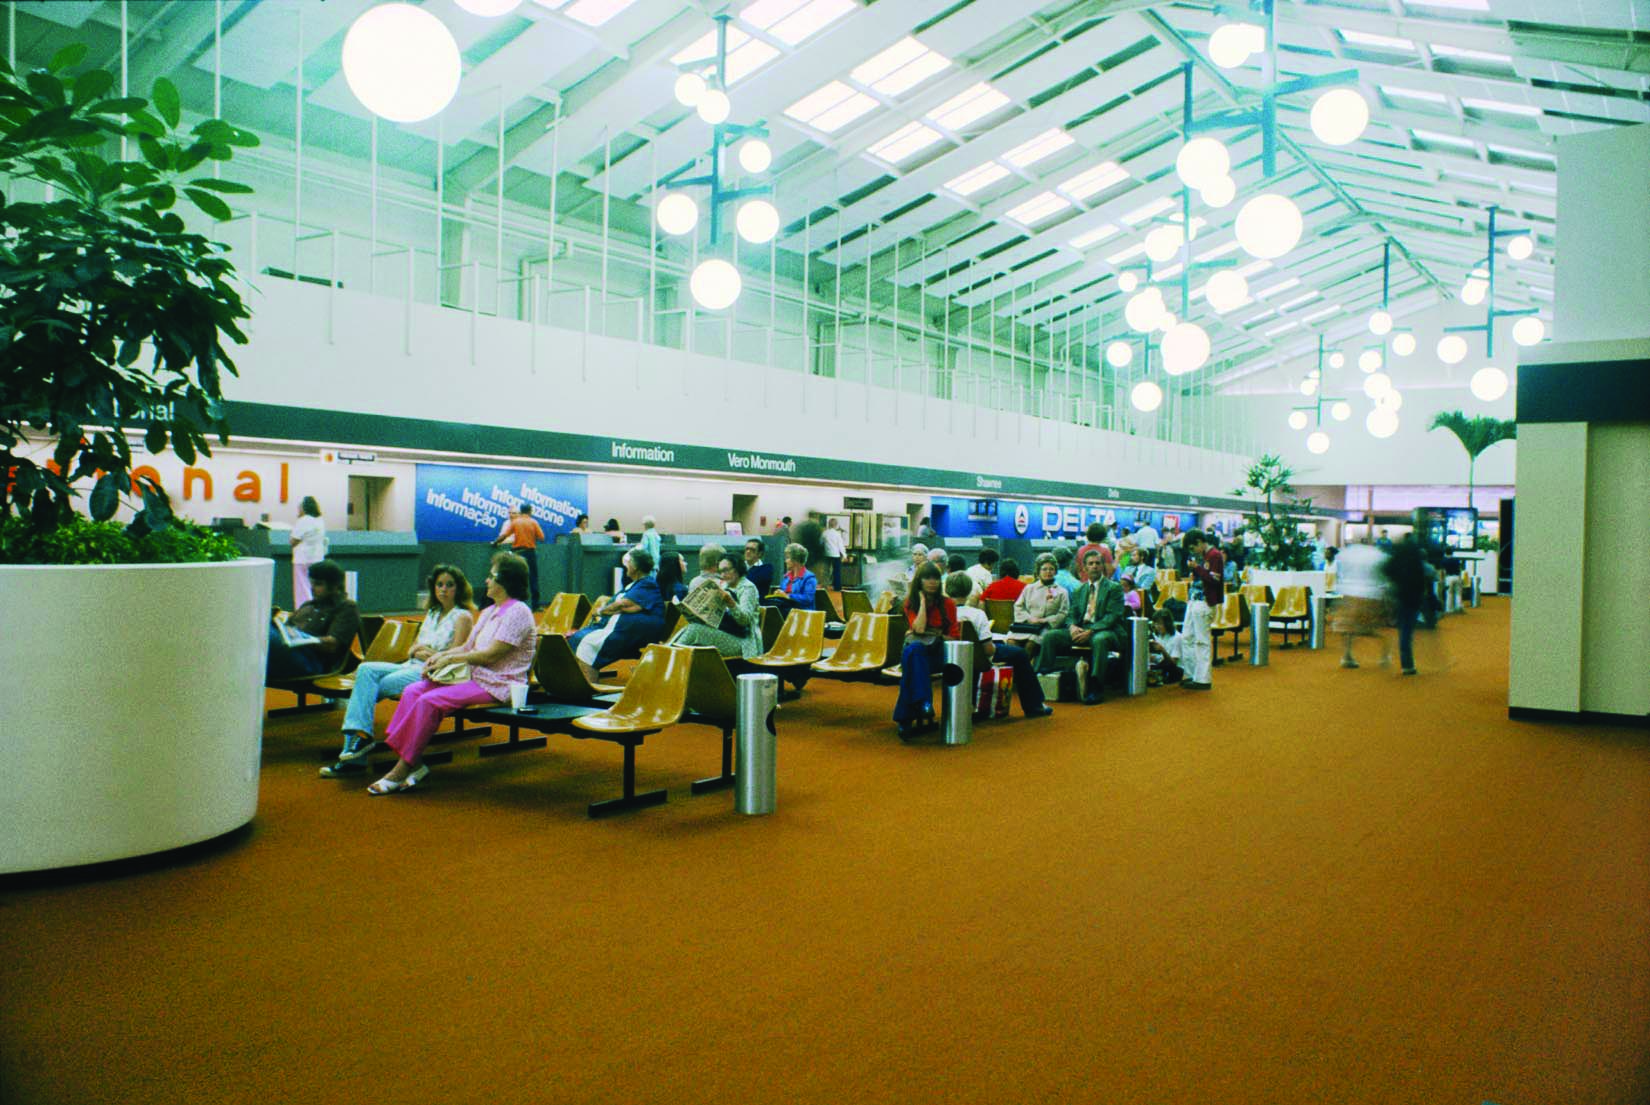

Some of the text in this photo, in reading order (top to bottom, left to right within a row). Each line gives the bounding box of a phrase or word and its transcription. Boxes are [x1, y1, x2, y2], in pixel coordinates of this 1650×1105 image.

[611, 441, 675, 463] Information
[727, 452, 797, 473] Vero Monmouth
[426, 487, 498, 529] Informação
[462, 487, 509, 519] Informa
[1041, 505, 1117, 533] DELTA
